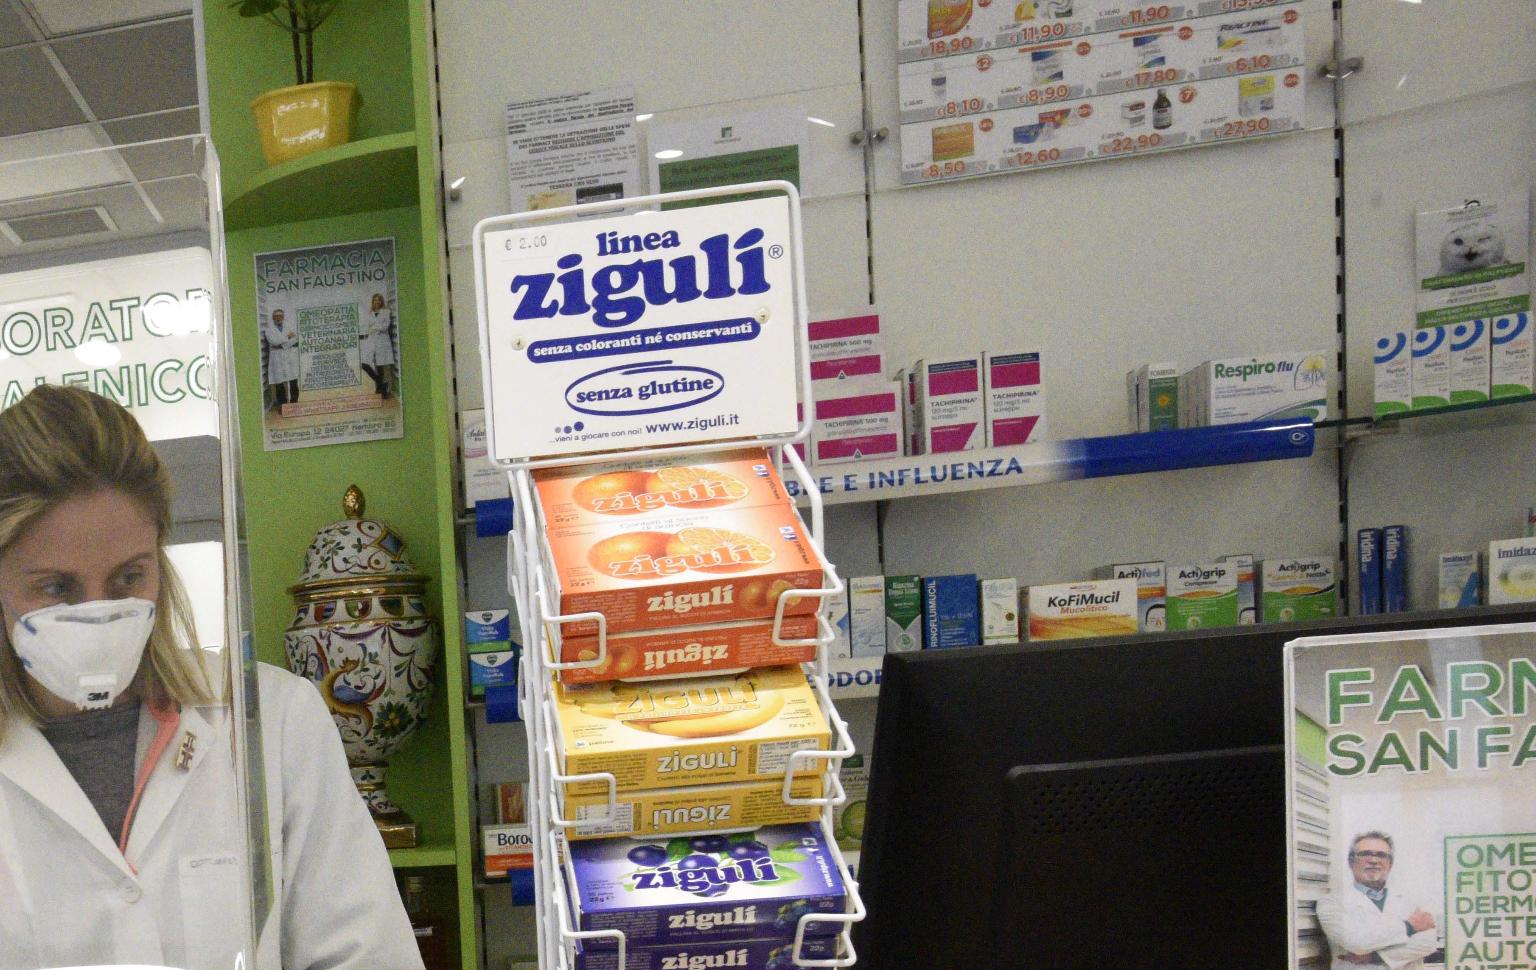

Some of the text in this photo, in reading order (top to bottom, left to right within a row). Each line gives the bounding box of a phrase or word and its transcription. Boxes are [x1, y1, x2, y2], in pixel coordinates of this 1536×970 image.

[596, 230, 681, 257] linea
[265, 249, 386, 279] FARMACIA
[266, 268, 386, 294] SAN FAUSTINO
[533, 321, 753, 358] senza coloranti né conservanti
[1214, 358, 1294, 382] Respiro flu
[576, 375, 714, 404] senza glutine
[582, 431, 610, 443] giocare
[611, 430, 626, 438] con
[844, 457, 1024, 491] E INFLUENZA
[1047, 590, 1120, 609] KoFiMucil
[926, 580, 938, 648] RINOFLUIMUCIL
[1327, 728, 1460, 777] SAN
[1456, 869, 1536, 894] FITO
[1455, 895, 1536, 915] DERM
